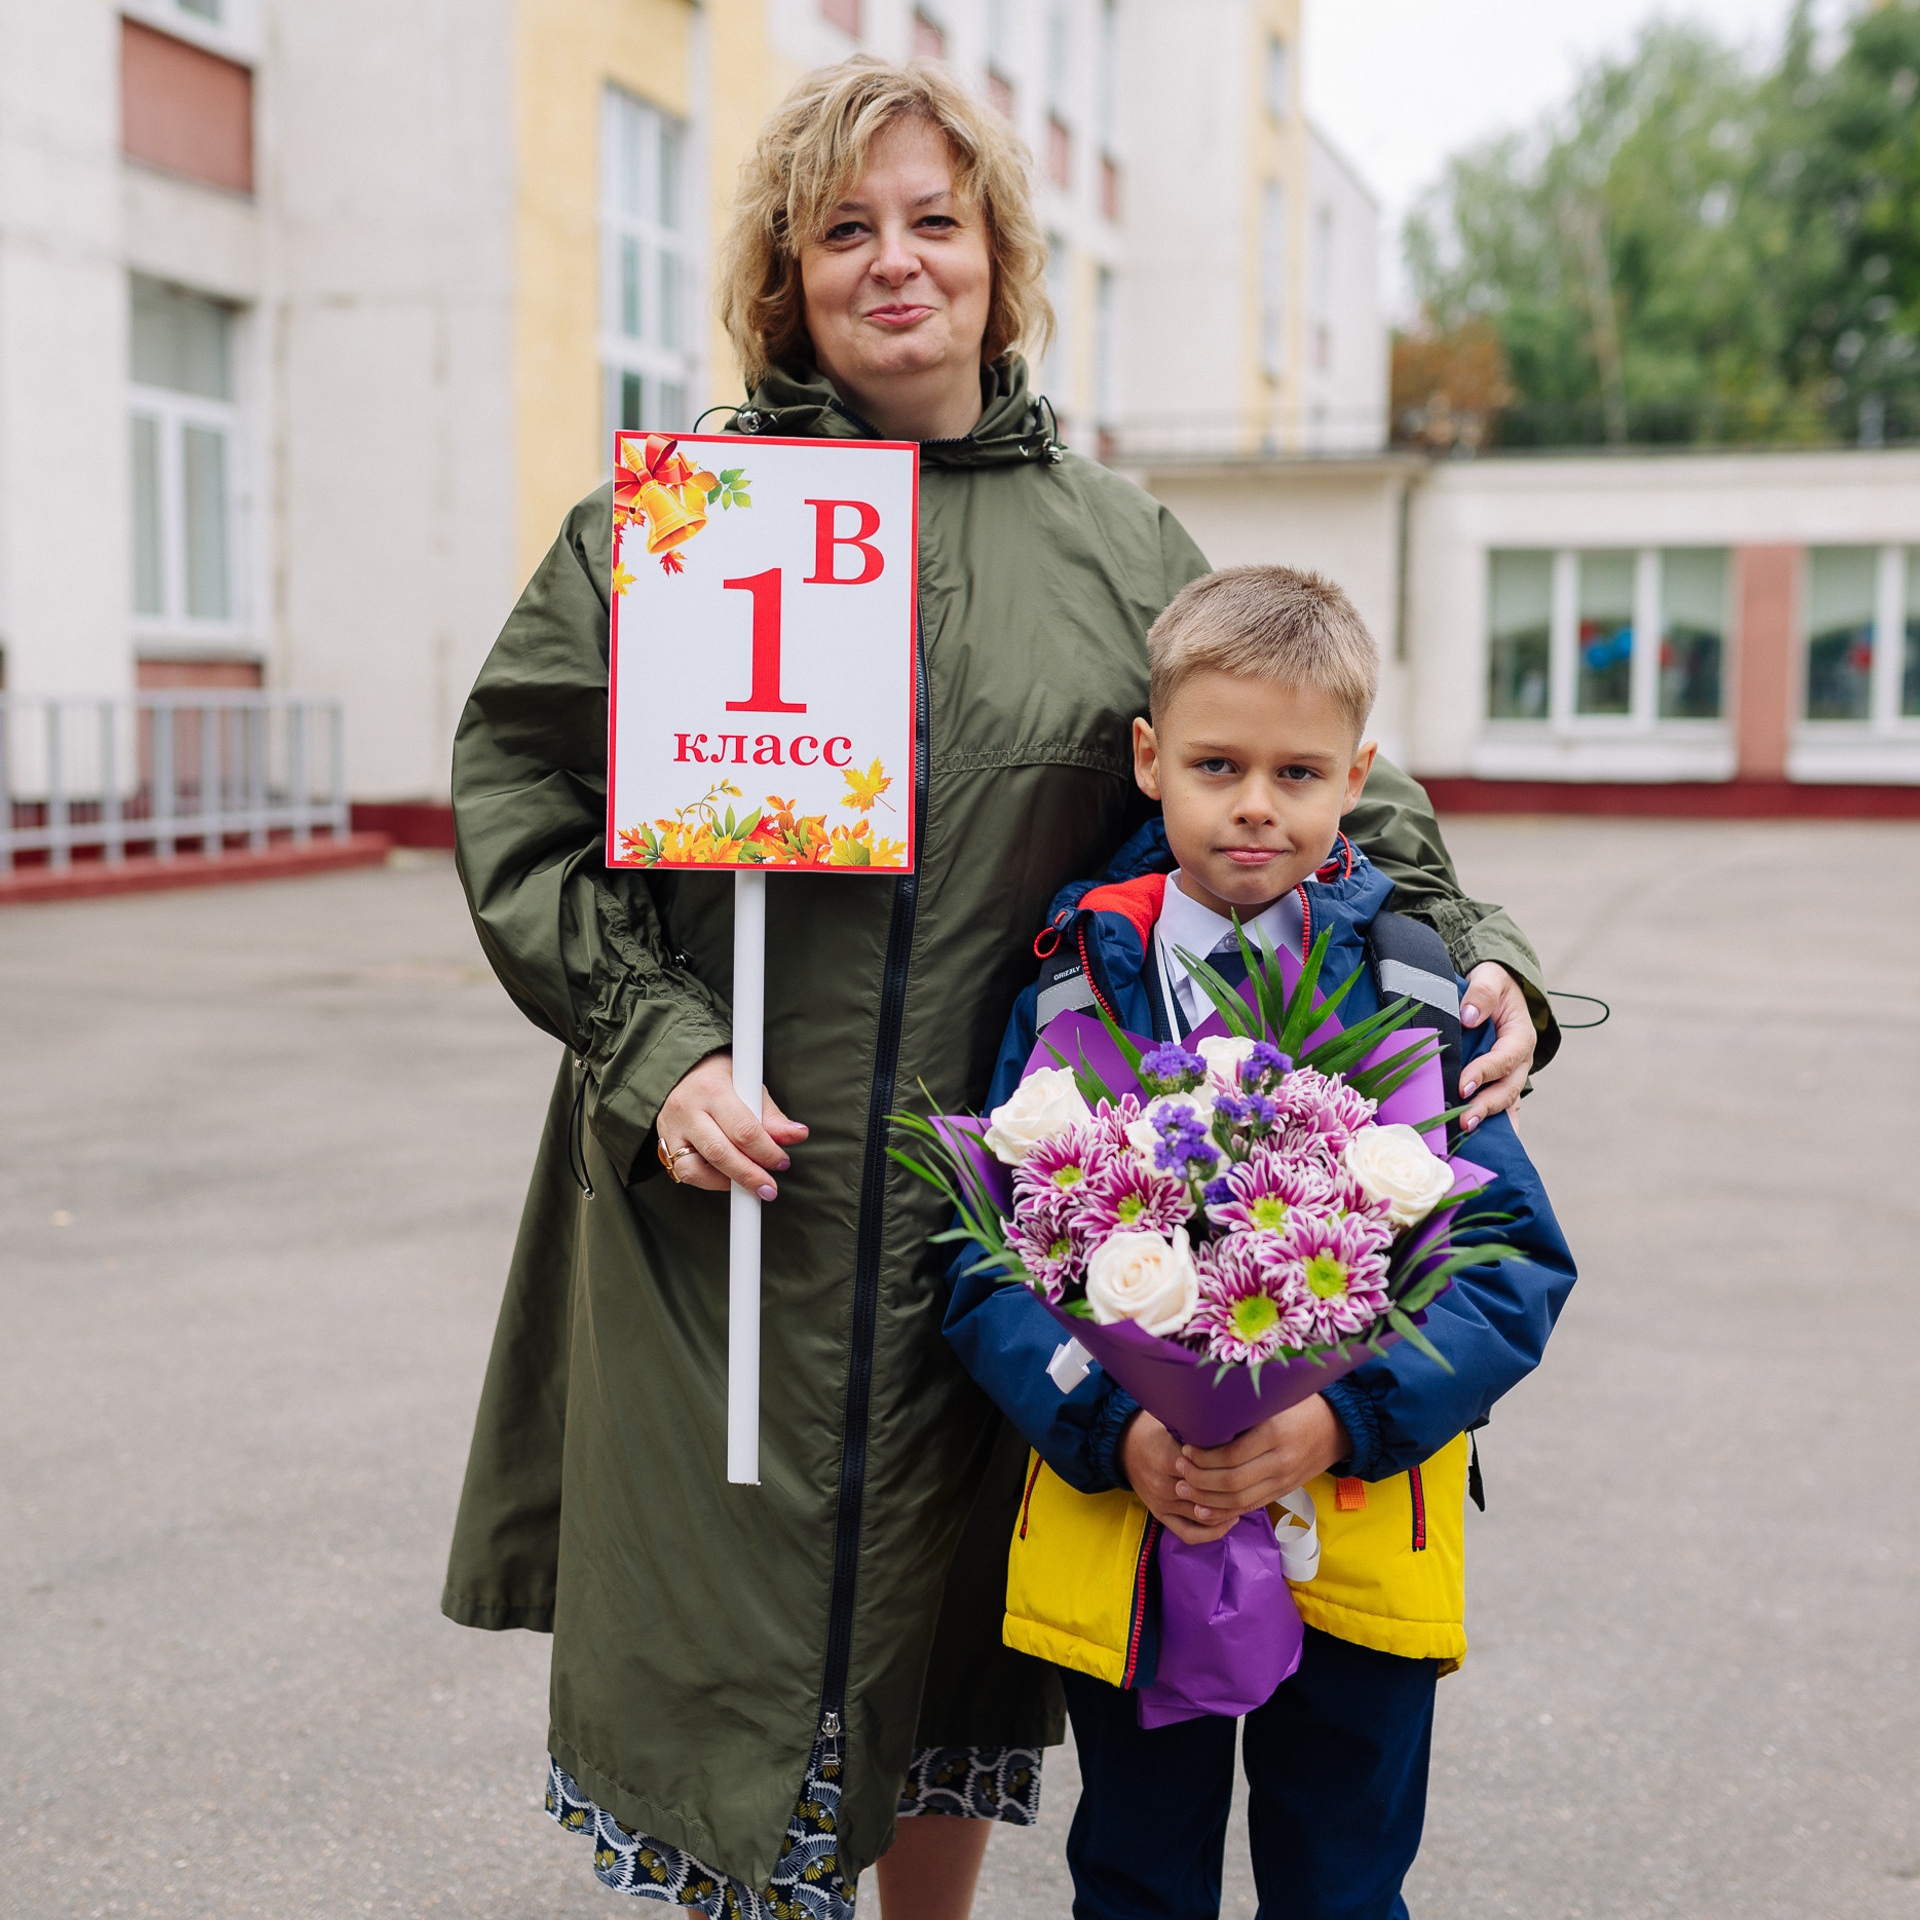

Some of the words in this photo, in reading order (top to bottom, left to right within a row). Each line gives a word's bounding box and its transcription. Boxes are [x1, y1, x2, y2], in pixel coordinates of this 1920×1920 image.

[803, 498, 885, 585] В
[723, 567, 807, 714] 1
[673, 732, 853, 767] класс
[1053, 966, 1080, 981] GRIZZLY
